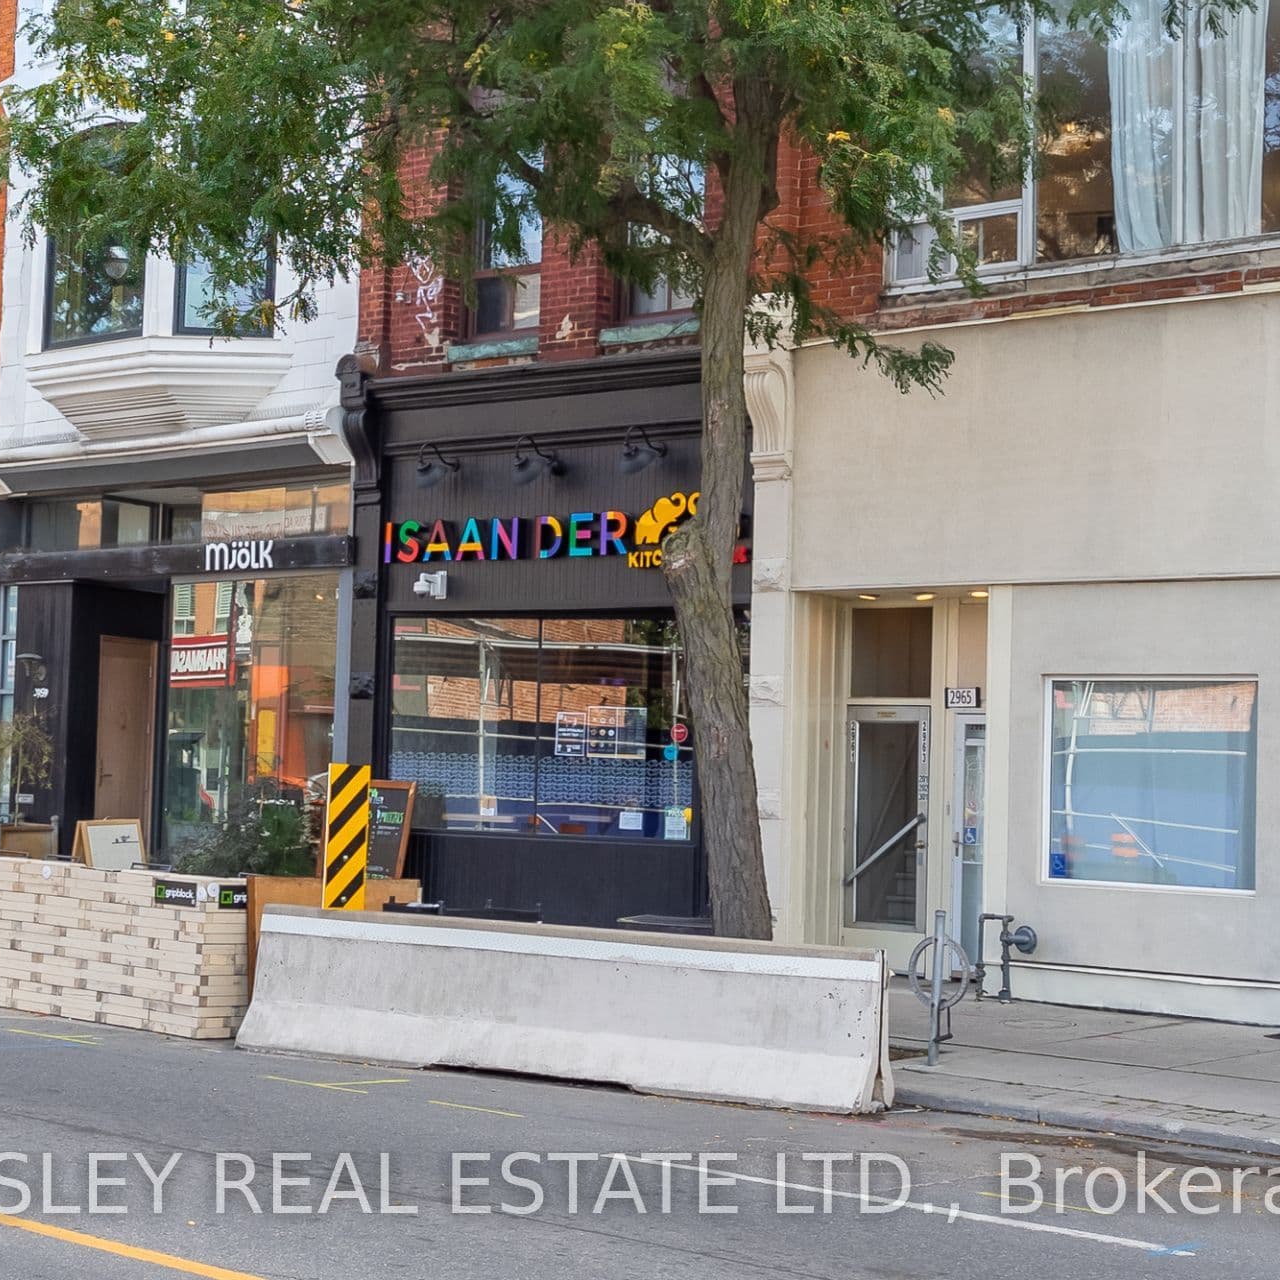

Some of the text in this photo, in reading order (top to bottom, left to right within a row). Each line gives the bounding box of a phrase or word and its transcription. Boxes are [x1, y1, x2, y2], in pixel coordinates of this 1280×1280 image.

[383, 516, 519, 564] ISAAN
[535, 511, 628, 559] DER
[627, 549, 663, 569] KITC
[949, 690, 972, 705] 2965
